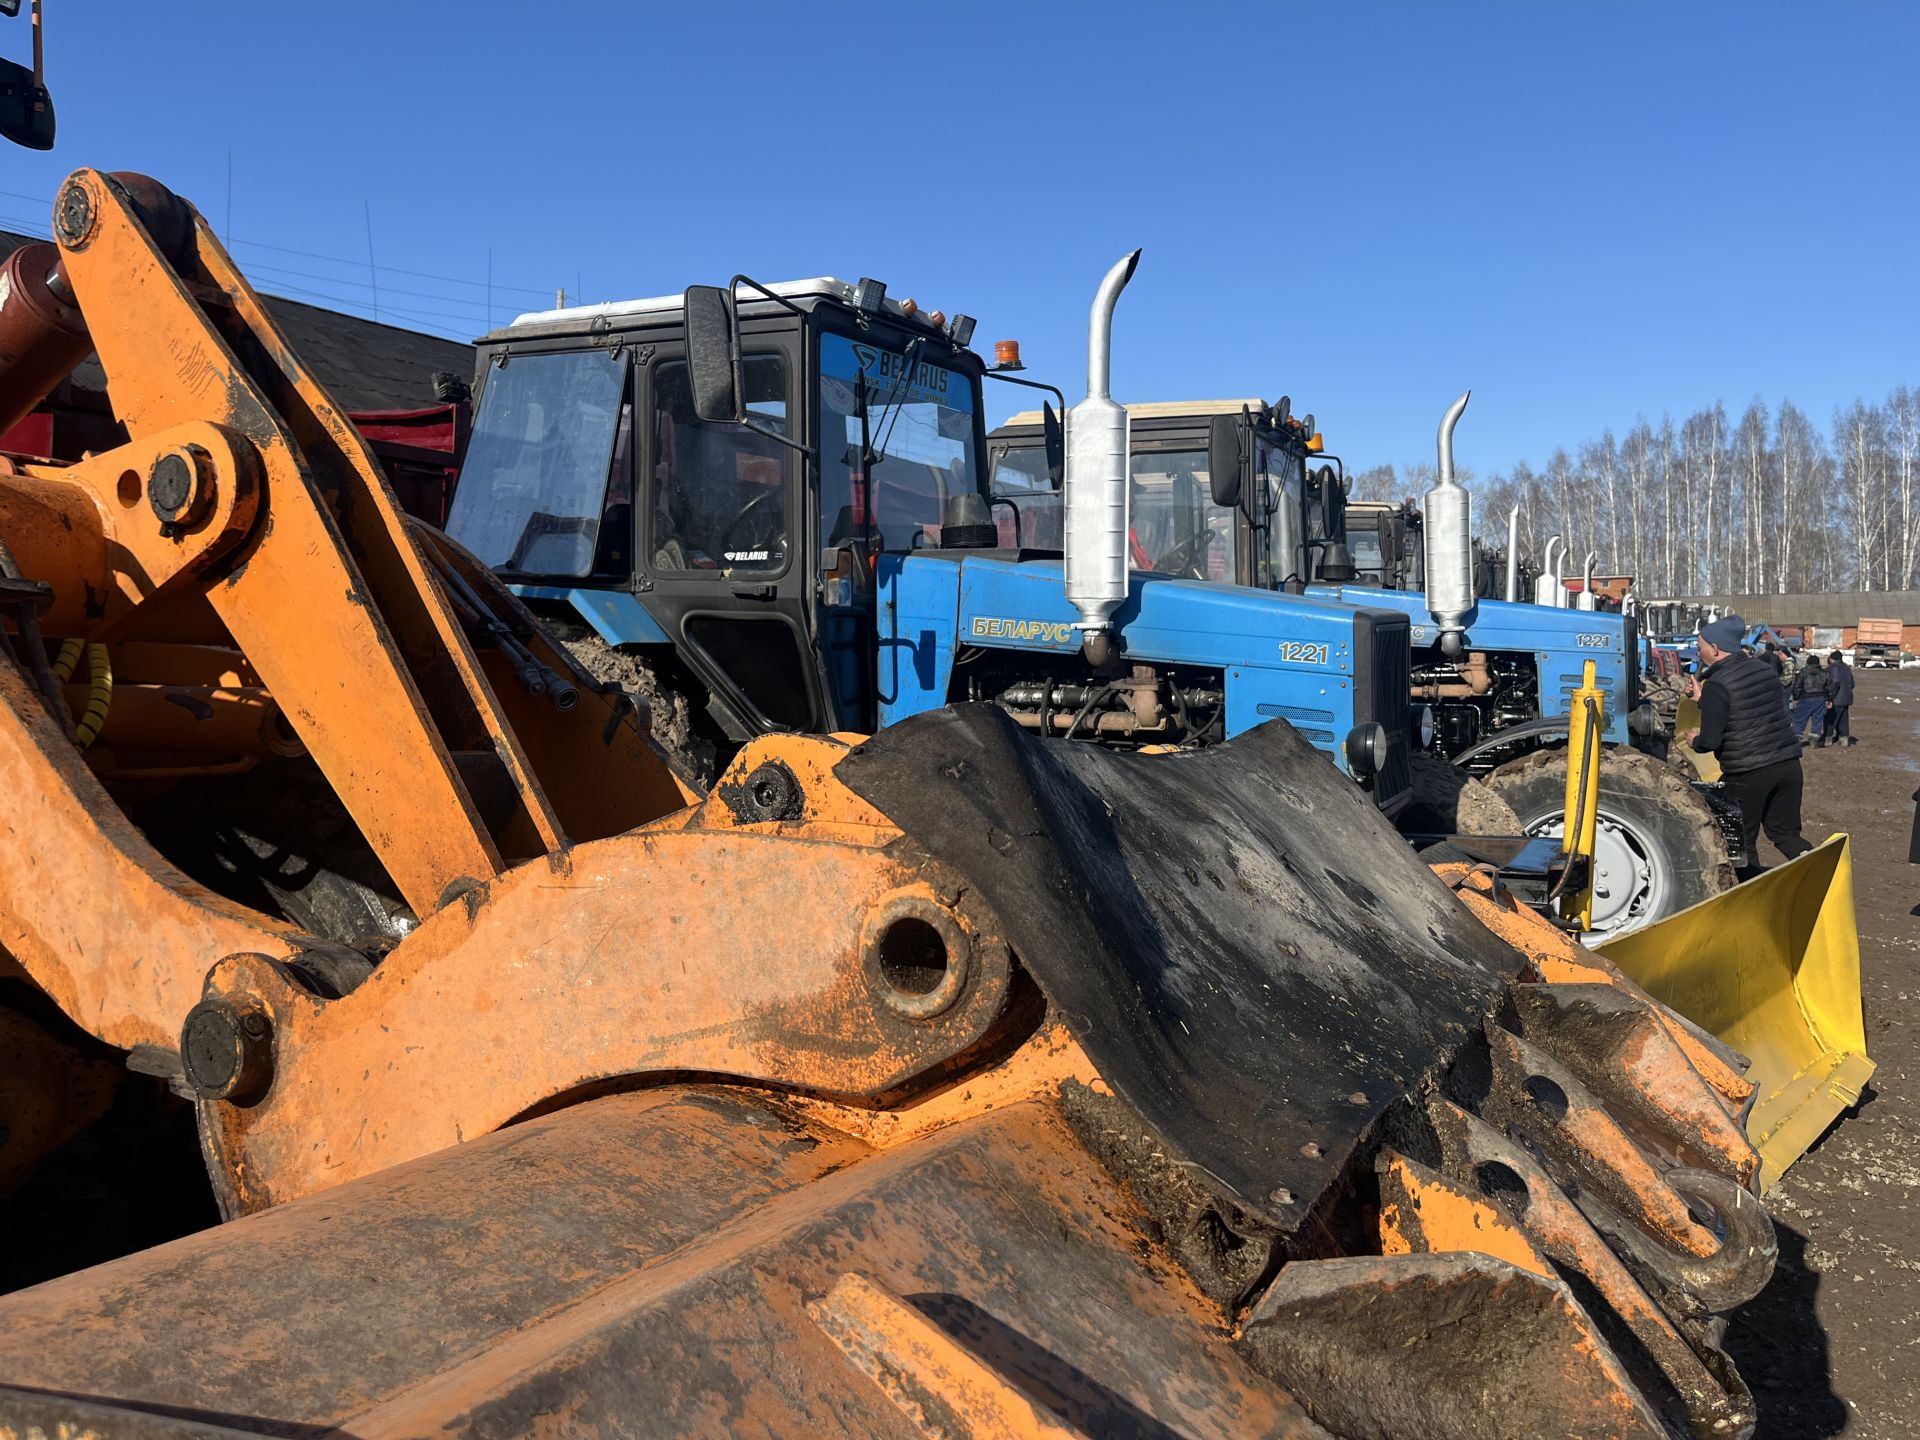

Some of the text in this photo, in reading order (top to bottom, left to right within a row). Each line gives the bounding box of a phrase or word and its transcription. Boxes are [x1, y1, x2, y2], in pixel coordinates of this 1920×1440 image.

[735, 551, 768, 561] BELARUS
[973, 617, 1071, 643] БЕЛАРУС
[1575, 633, 1610, 648] 1221
[1279, 641, 1328, 664] 1221
